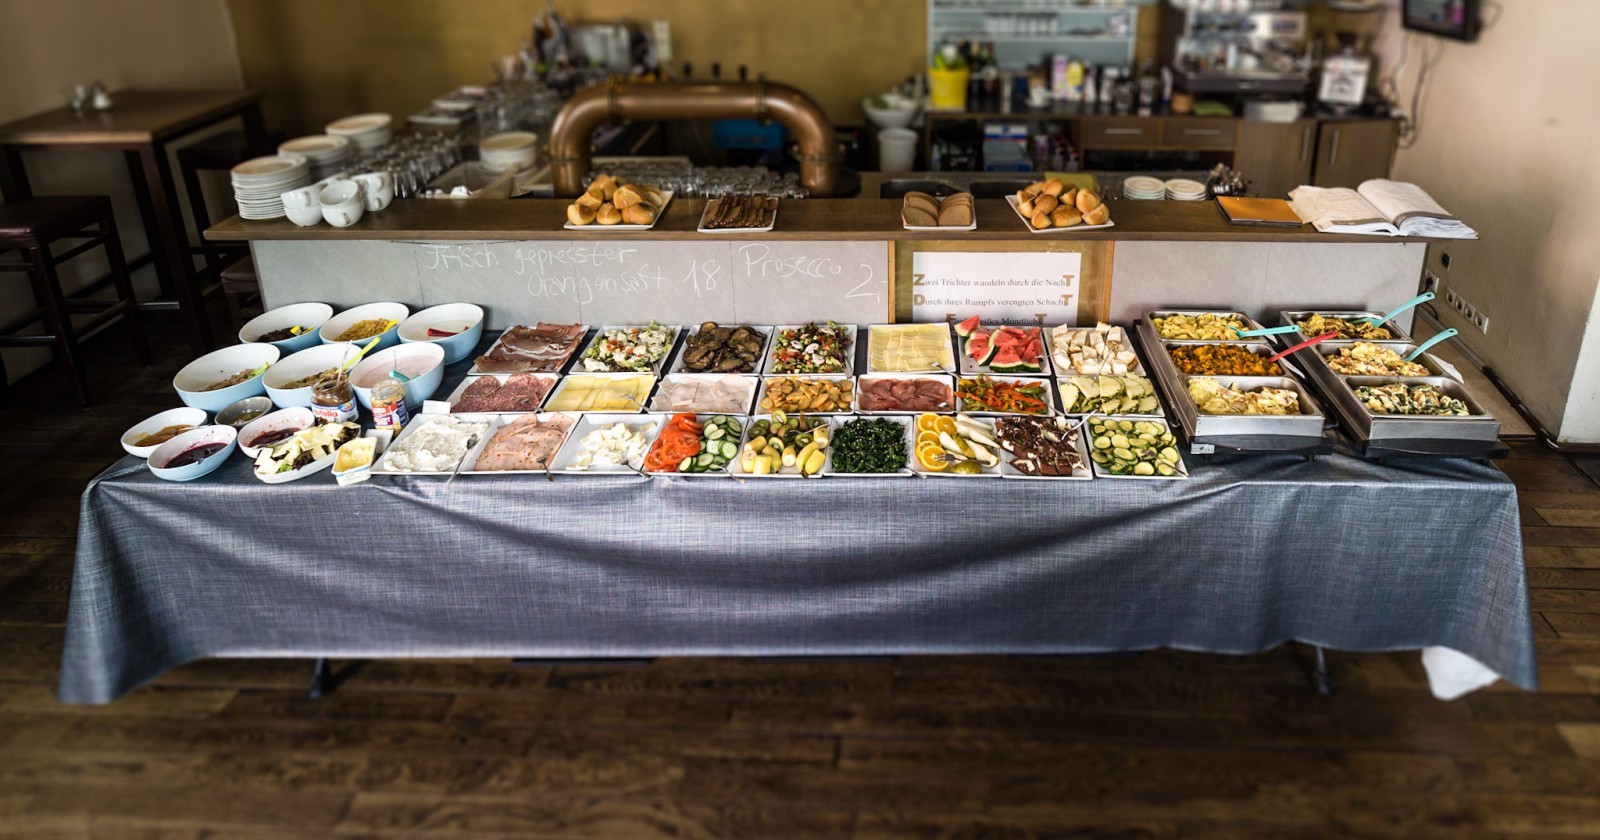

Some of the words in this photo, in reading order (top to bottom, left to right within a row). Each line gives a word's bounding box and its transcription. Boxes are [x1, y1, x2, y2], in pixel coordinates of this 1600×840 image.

[738, 243, 842, 278] Prosecco
[913, 273, 939, 286] Zwei
[940, 278, 971, 287] Trichter
[973, 278, 1006, 287] wandeln
[1007, 278, 1030, 287] durch
[1031, 278, 1043, 287] die
[913, 293, 943, 306] Durch
[944, 298, 963, 306] ihres
[965, 298, 995, 308] Rumpfs
[997, 298, 1035, 308] verengten
